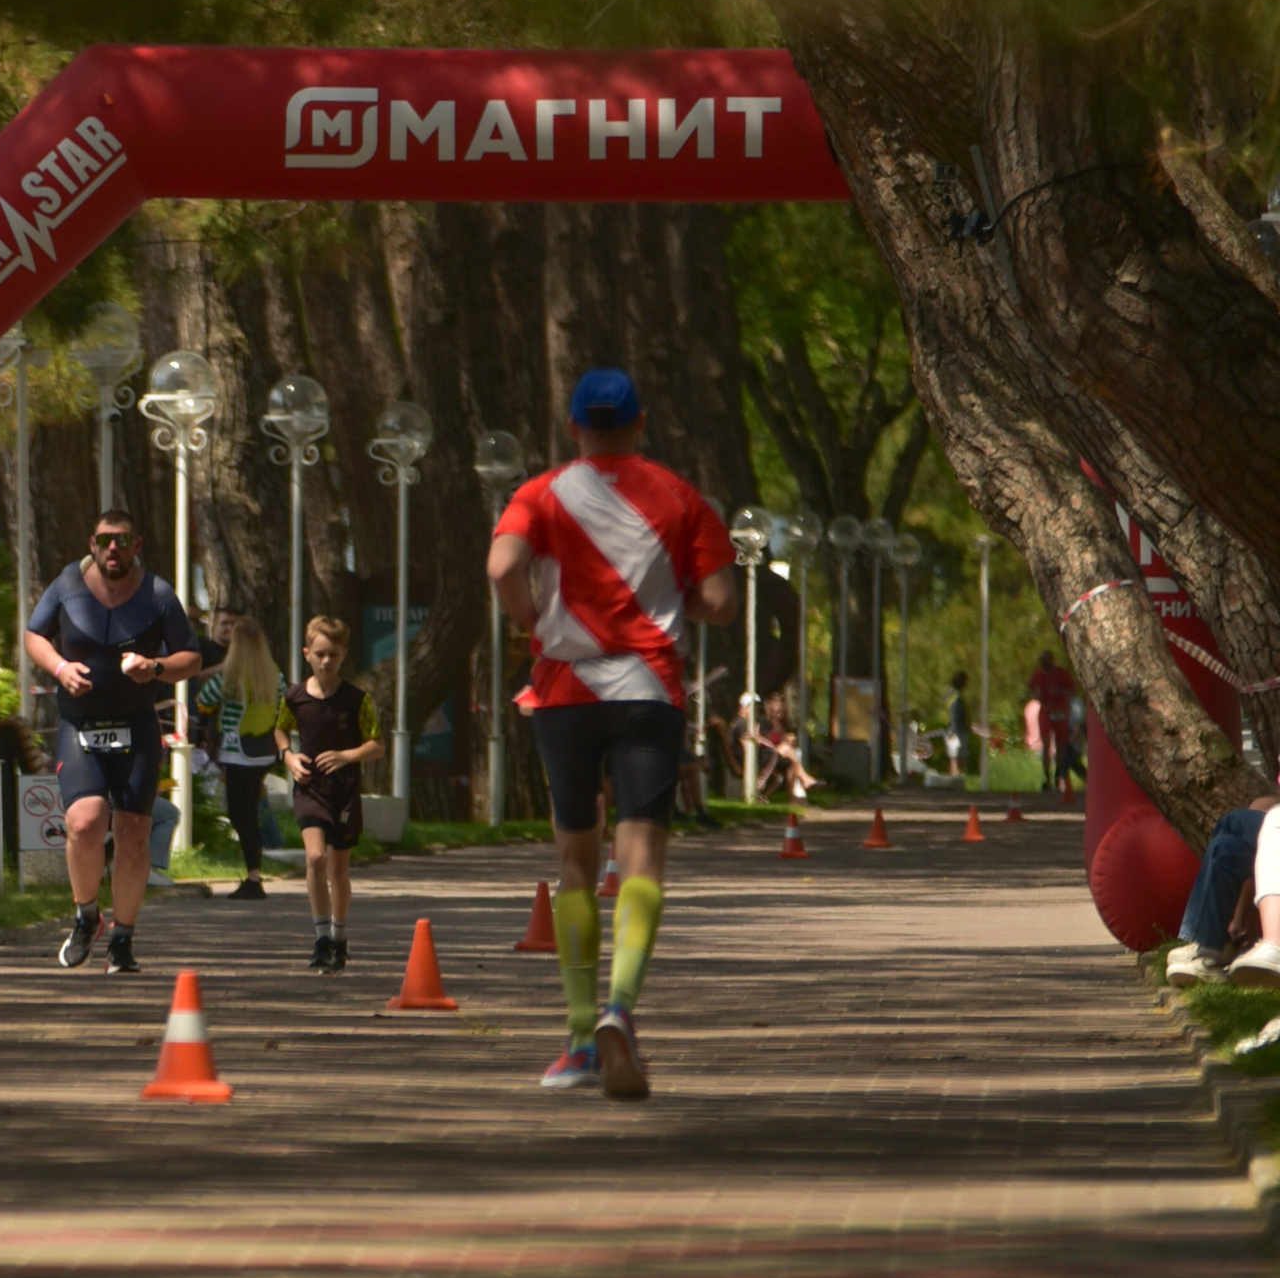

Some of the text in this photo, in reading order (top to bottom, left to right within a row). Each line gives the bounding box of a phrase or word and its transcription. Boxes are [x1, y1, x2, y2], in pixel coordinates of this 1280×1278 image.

[389, 96, 783, 162] МАГНИТ
[21, 115, 125, 216] STAR
[93, 732, 118, 745] 270
